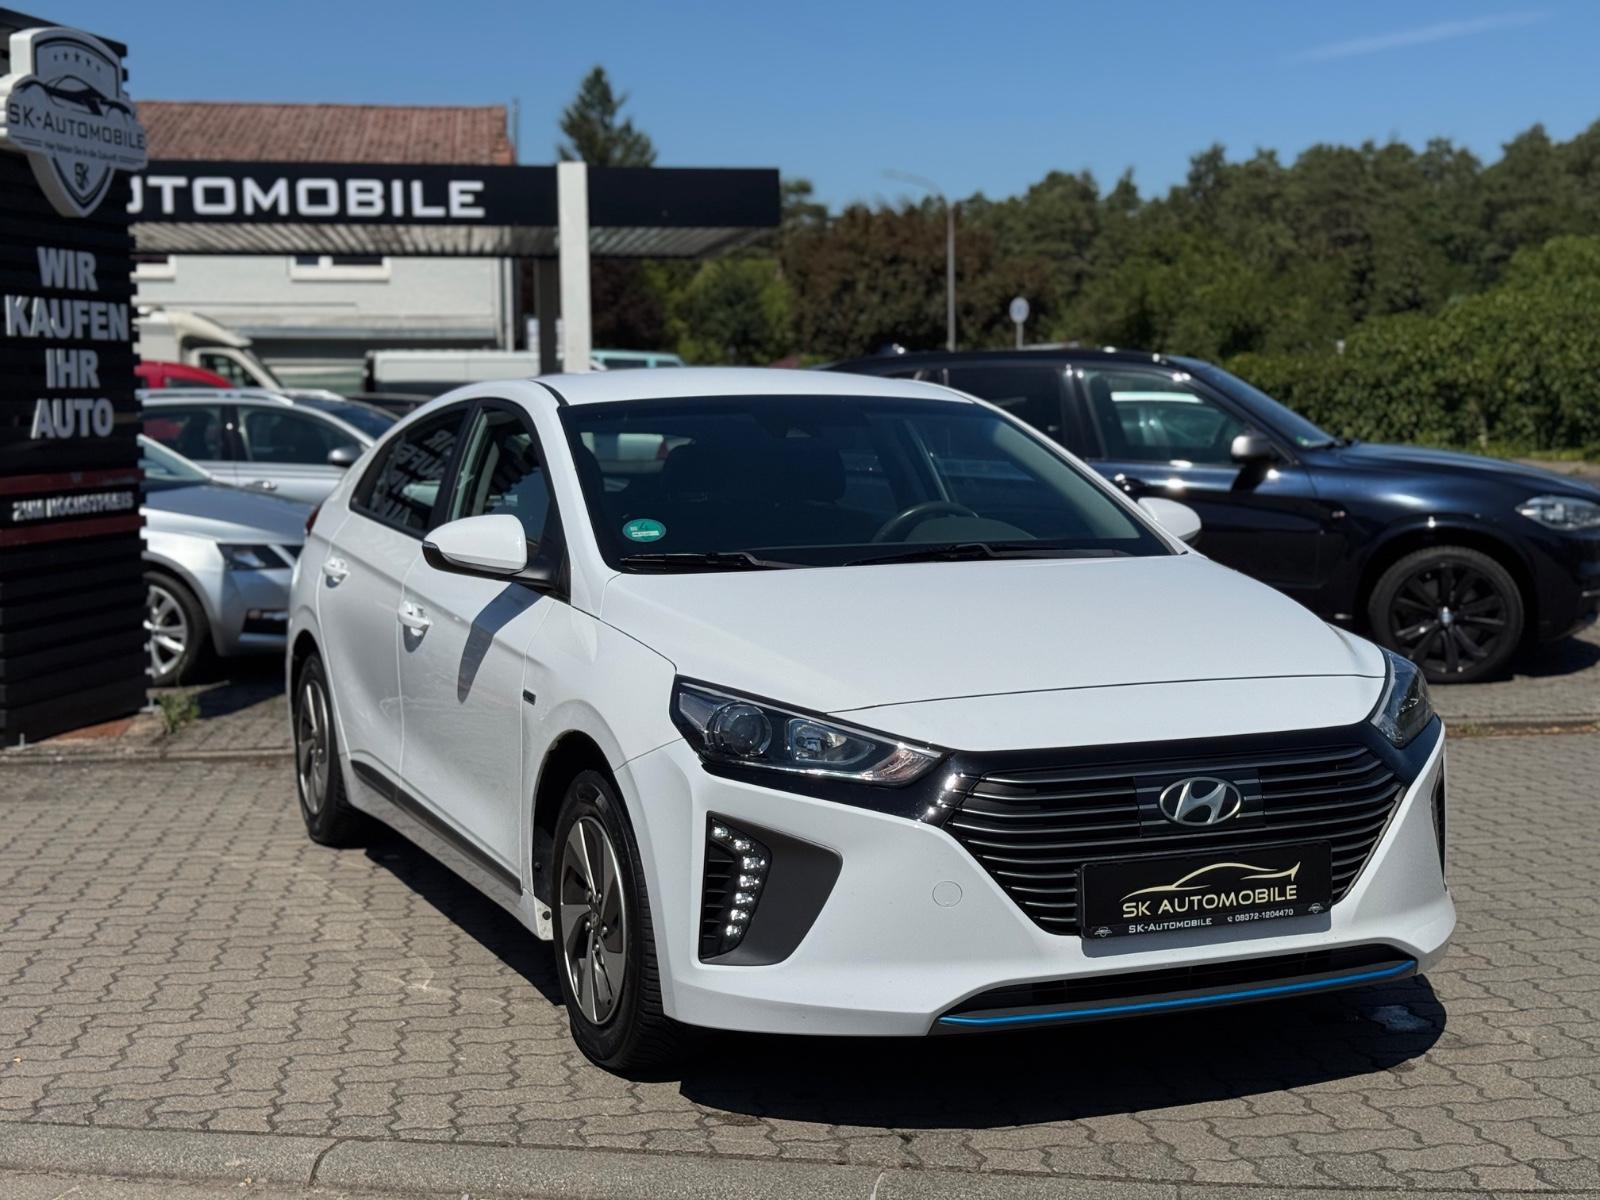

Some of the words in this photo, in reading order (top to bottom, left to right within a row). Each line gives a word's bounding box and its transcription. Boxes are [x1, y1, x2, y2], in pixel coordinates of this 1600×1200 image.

[37, 246, 98, 291] WIR
[5, 294, 129, 341] KAUFEN
[45, 348, 100, 389] IHR
[30, 398, 114, 439] AUTO
[1122, 900, 1151, 919] SK
[1157, 884, 1298, 915] AUTOMOBILE
[1128, 917, 1213, 934] SK-AUTOMOBILE
